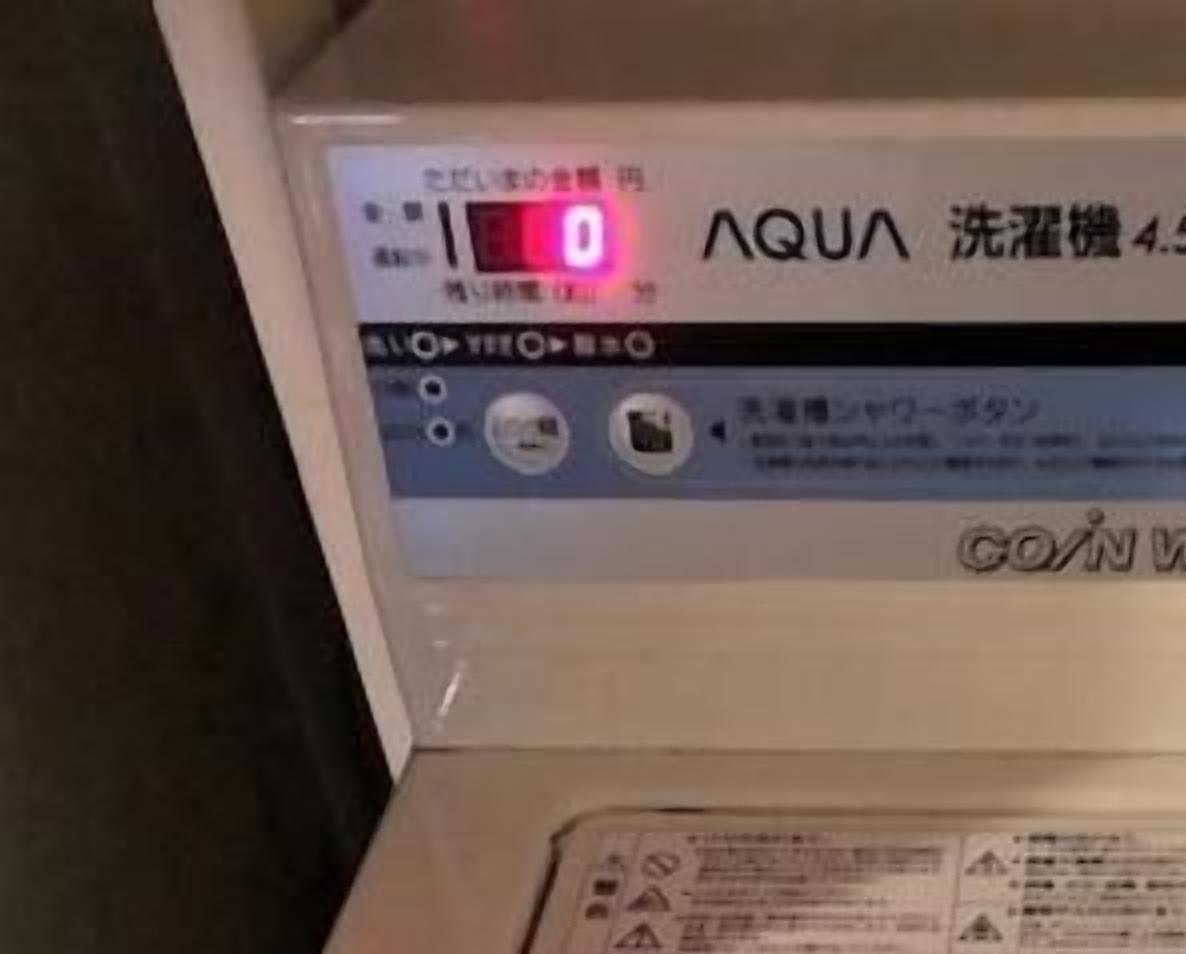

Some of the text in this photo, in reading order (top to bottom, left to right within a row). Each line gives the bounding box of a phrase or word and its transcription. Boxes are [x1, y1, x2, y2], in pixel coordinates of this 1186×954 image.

[561, 203, 605, 269] 0
[703, 207, 911, 261] AQUA
[949, 204, 1123, 260] 洗濯機
[957, 507, 1137, 574] COIN
